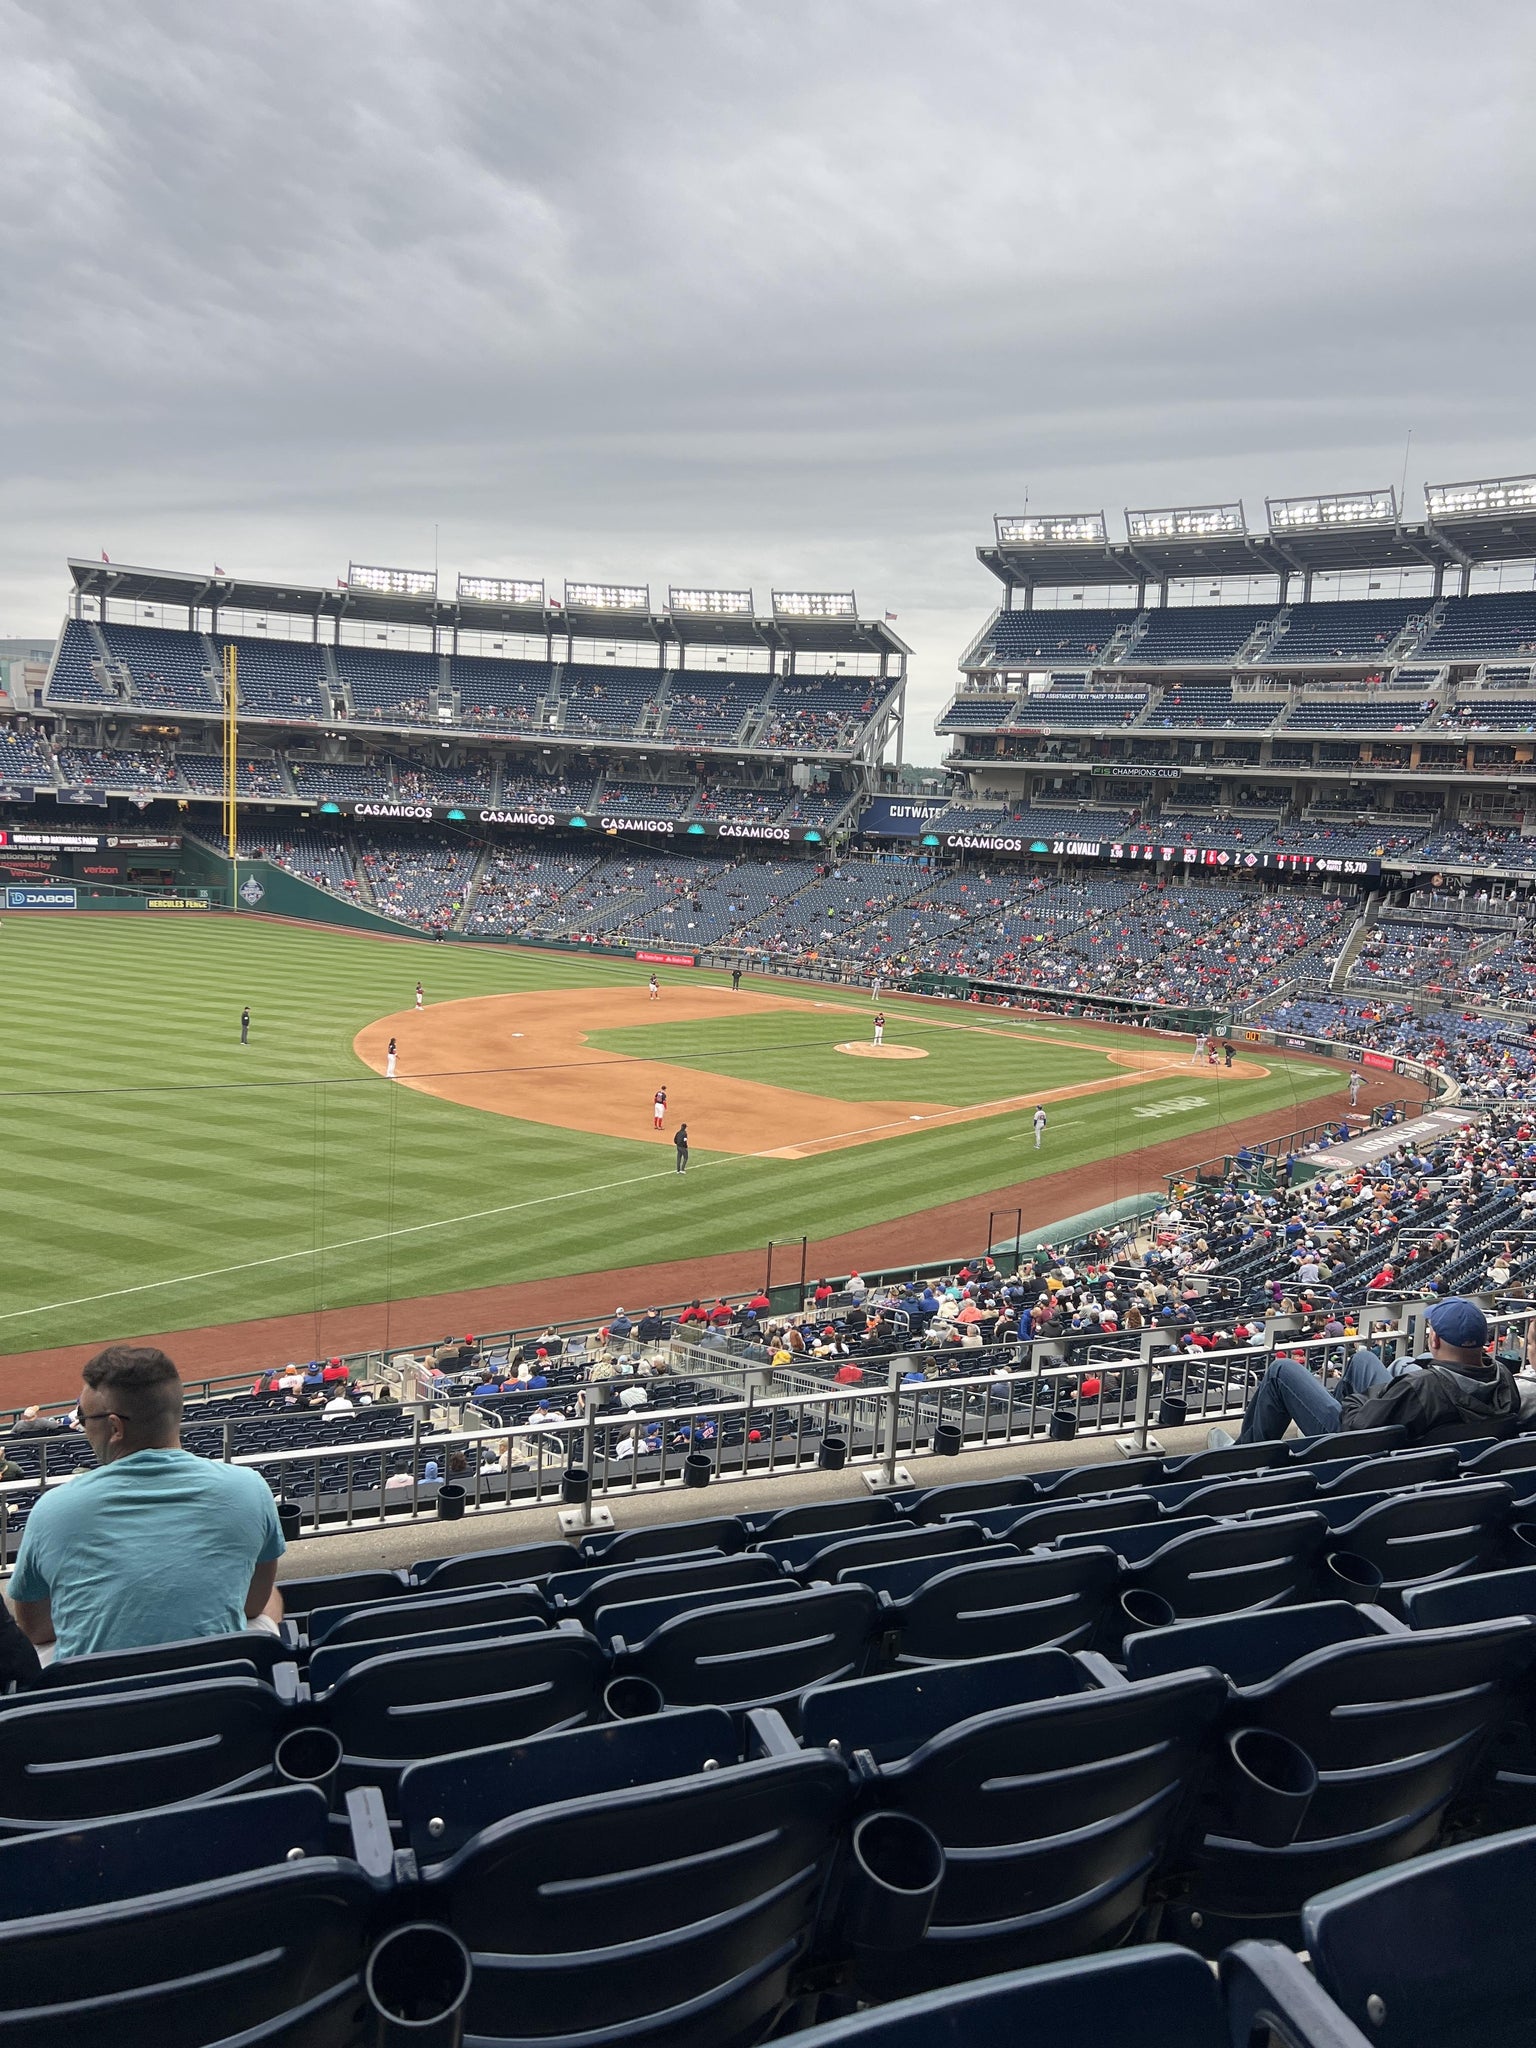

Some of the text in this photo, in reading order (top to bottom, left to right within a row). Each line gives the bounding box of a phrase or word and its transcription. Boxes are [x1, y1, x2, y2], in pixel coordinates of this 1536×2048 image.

[1112, 768, 1157, 776] CHAMPIONS
[1158, 769, 1178, 777] CLUB
[354, 803, 433, 819] CASAMIGOS
[480, 810, 555, 825] CASAMIGOS
[601, 817, 674, 833] CASAMIGOS
[719, 824, 790, 840] CASAMIGOS
[13, 834, 42, 844] WELCOME
[42, 835, 50, 844] TO
[50, 836, 82, 845] NATIONALS
[82, 837, 99, 846] PARK
[947, 835, 1022, 851] CASAMIGOS
[1053, 841, 1064, 854] 24
[1067, 842, 1100, 856] CAVALLI
[37, 853, 58, 861] Park
[1234, 853, 1241, 864] 2
[1263, 854, 1269, 867] 1
[40, 861, 51, 870] by
[83, 865, 119, 875] verizon
[1344, 860, 1368, 874] $5,710
[26, 894, 74, 903] DABOS
[148, 899, 185, 908] HERCULES
[1245, 1030, 1261, 1041] 007
[1352, 1121, 1441, 1154] NATIONALS PARK
